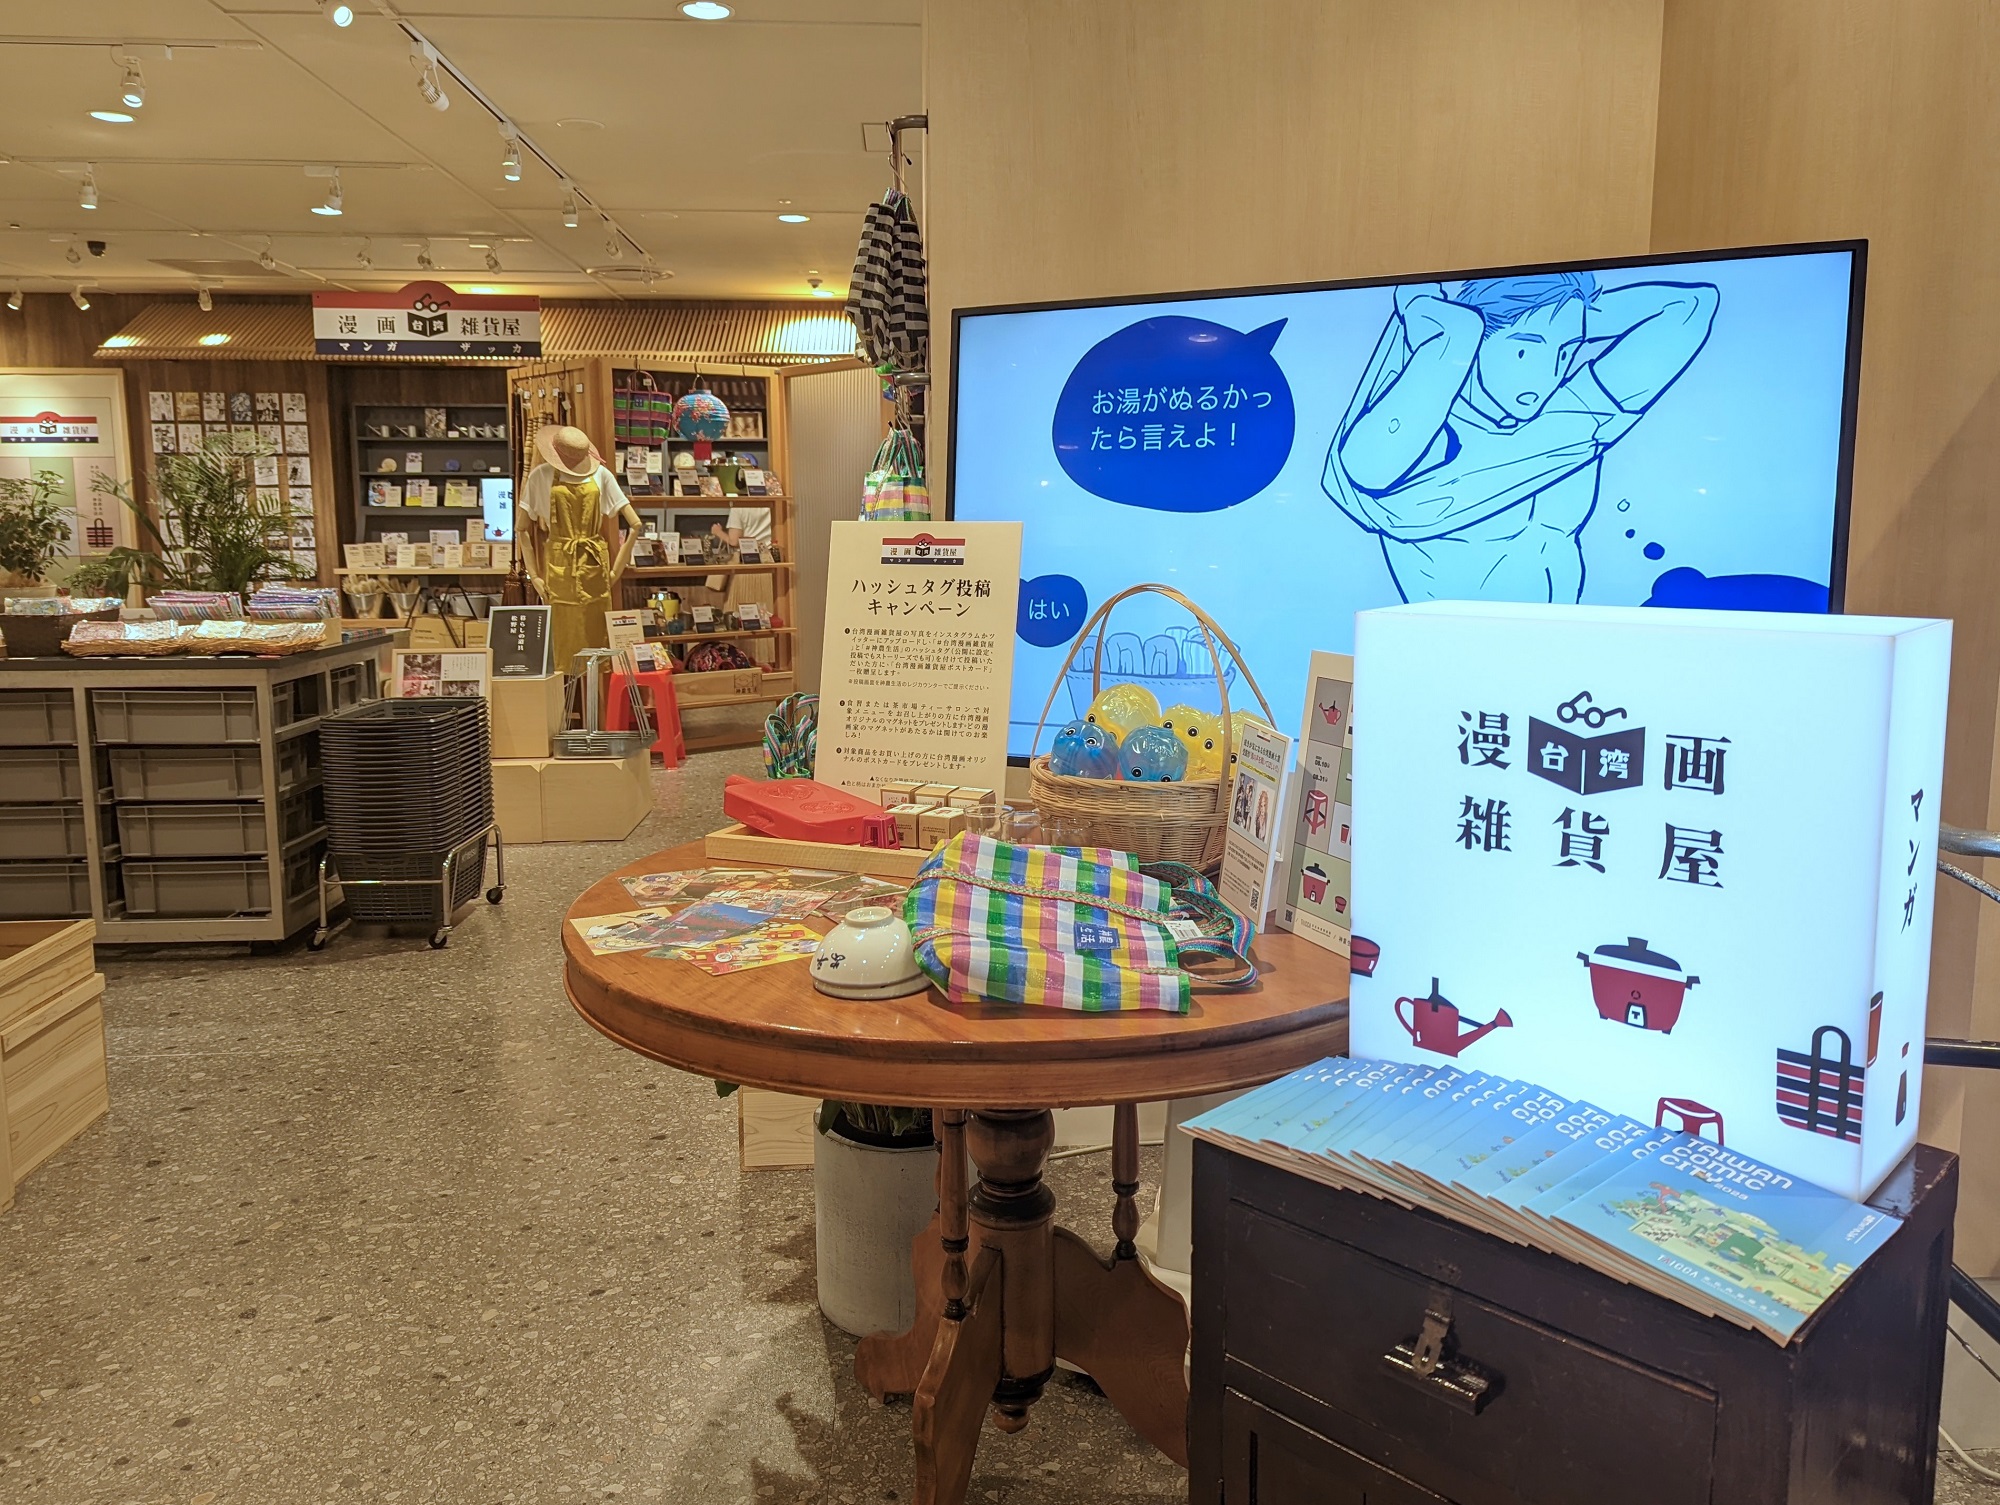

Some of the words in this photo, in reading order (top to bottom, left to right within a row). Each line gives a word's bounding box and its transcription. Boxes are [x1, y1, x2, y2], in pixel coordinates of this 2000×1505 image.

[338, 314, 396, 334] 漫画
[460, 316, 521, 337] 雑貨屋
[338, 341, 398, 352] マンガ
[460, 342, 522, 354] ザッカ
[1092, 384, 1272, 415] お湯がぬるかっ
[1091, 422, 1236, 451] たら言えよ！
[851, 579, 992, 598] ハッシュタグ投稿
[867, 598, 971, 617] キャンペーン
[1028, 598, 1070, 620] はい
[1539, 741, 1631, 779] 台湾
[1455, 794, 1724, 889] 雑貨屋
[1901, 788, 1924, 935] マンガ
[1659, 1154, 1724, 1183] CITY
[1671, 1146, 1766, 1191] COMIC
[1686, 1138, 1793, 1190] TAIWAN
